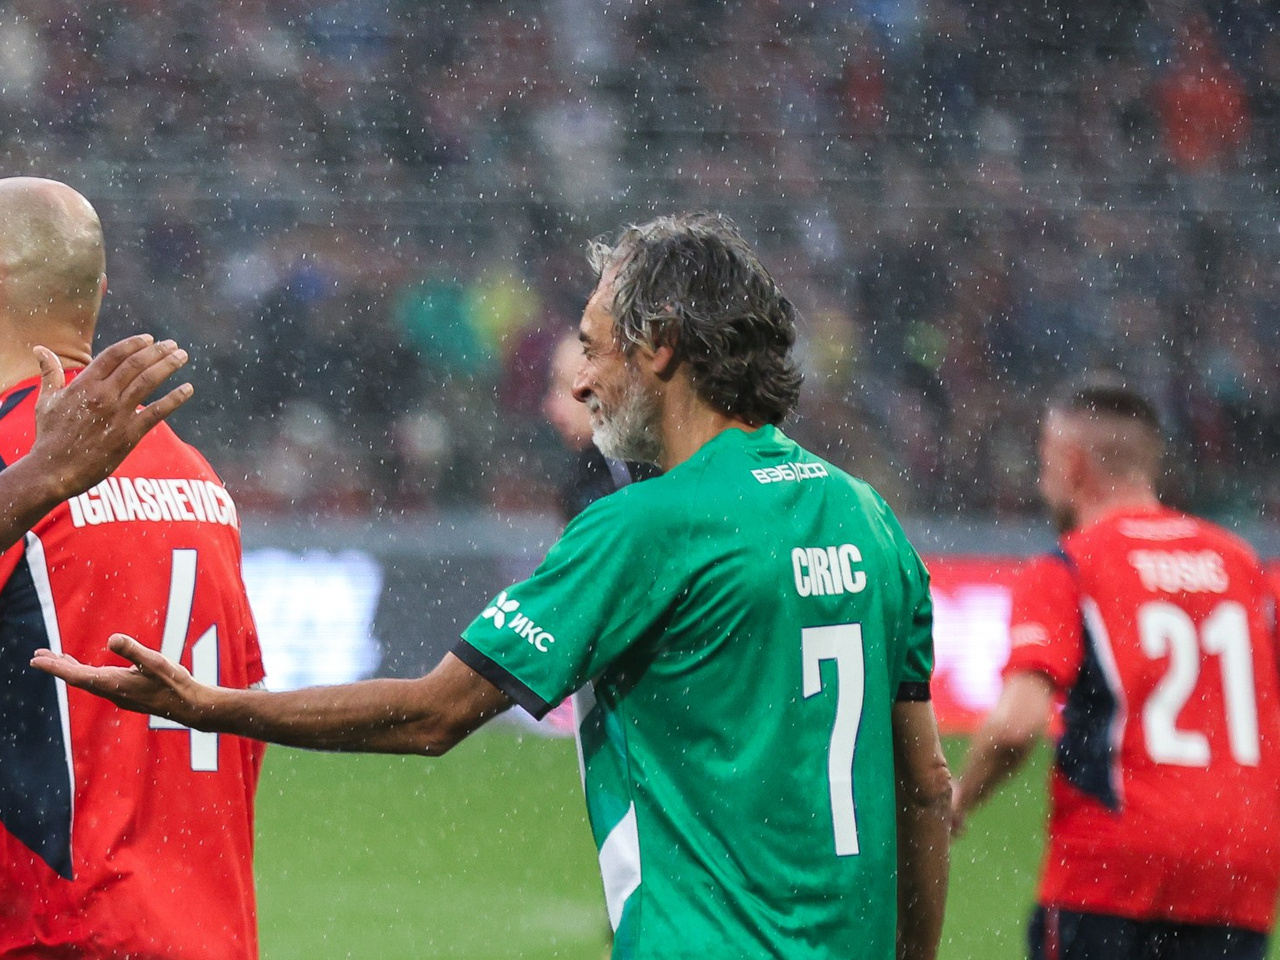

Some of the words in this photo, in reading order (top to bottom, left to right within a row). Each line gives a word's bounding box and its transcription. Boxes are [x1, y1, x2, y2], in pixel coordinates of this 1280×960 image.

[507, 612, 555, 653] ИКС
[791, 544, 867, 597] CIRIC
[148, 548, 220, 772] 4
[801, 622, 865, 857] 7
[1137, 600, 1261, 768] 21
